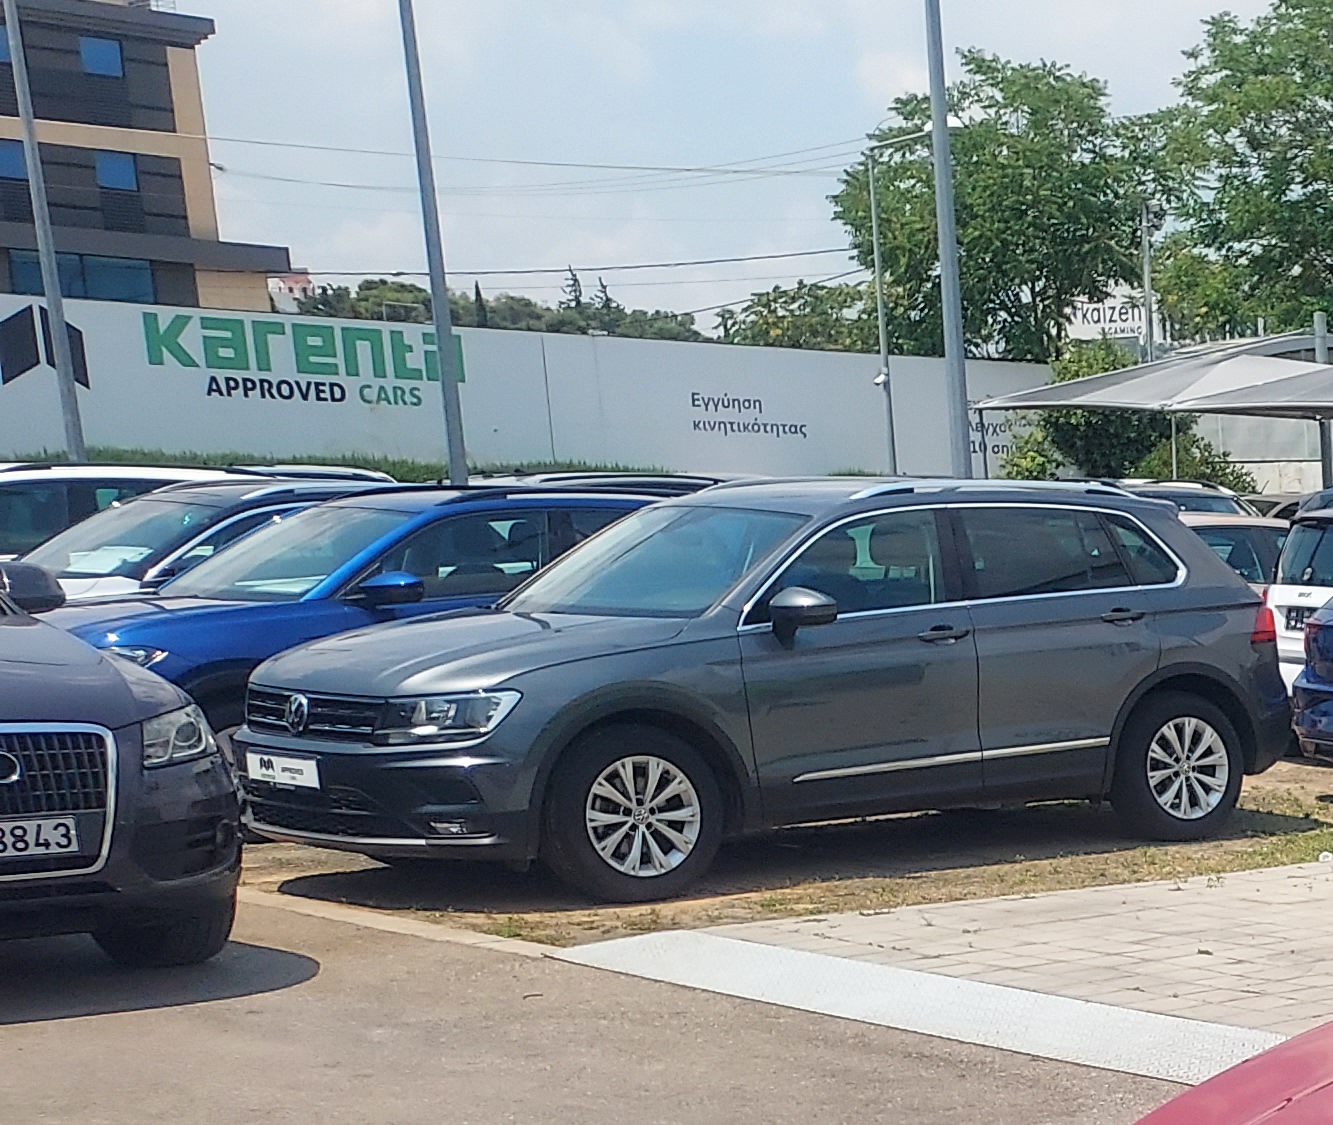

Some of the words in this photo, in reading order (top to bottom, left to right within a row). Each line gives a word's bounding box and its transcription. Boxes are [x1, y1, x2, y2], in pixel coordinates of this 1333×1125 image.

[1081, 302, 1142, 325] kaizen
[206, 376, 346, 402] APPROVED
[359, 384, 423, 407] CARS
[691, 392, 763, 414] Εγγύηση
[693, 417, 808, 439] κινητικότητας
